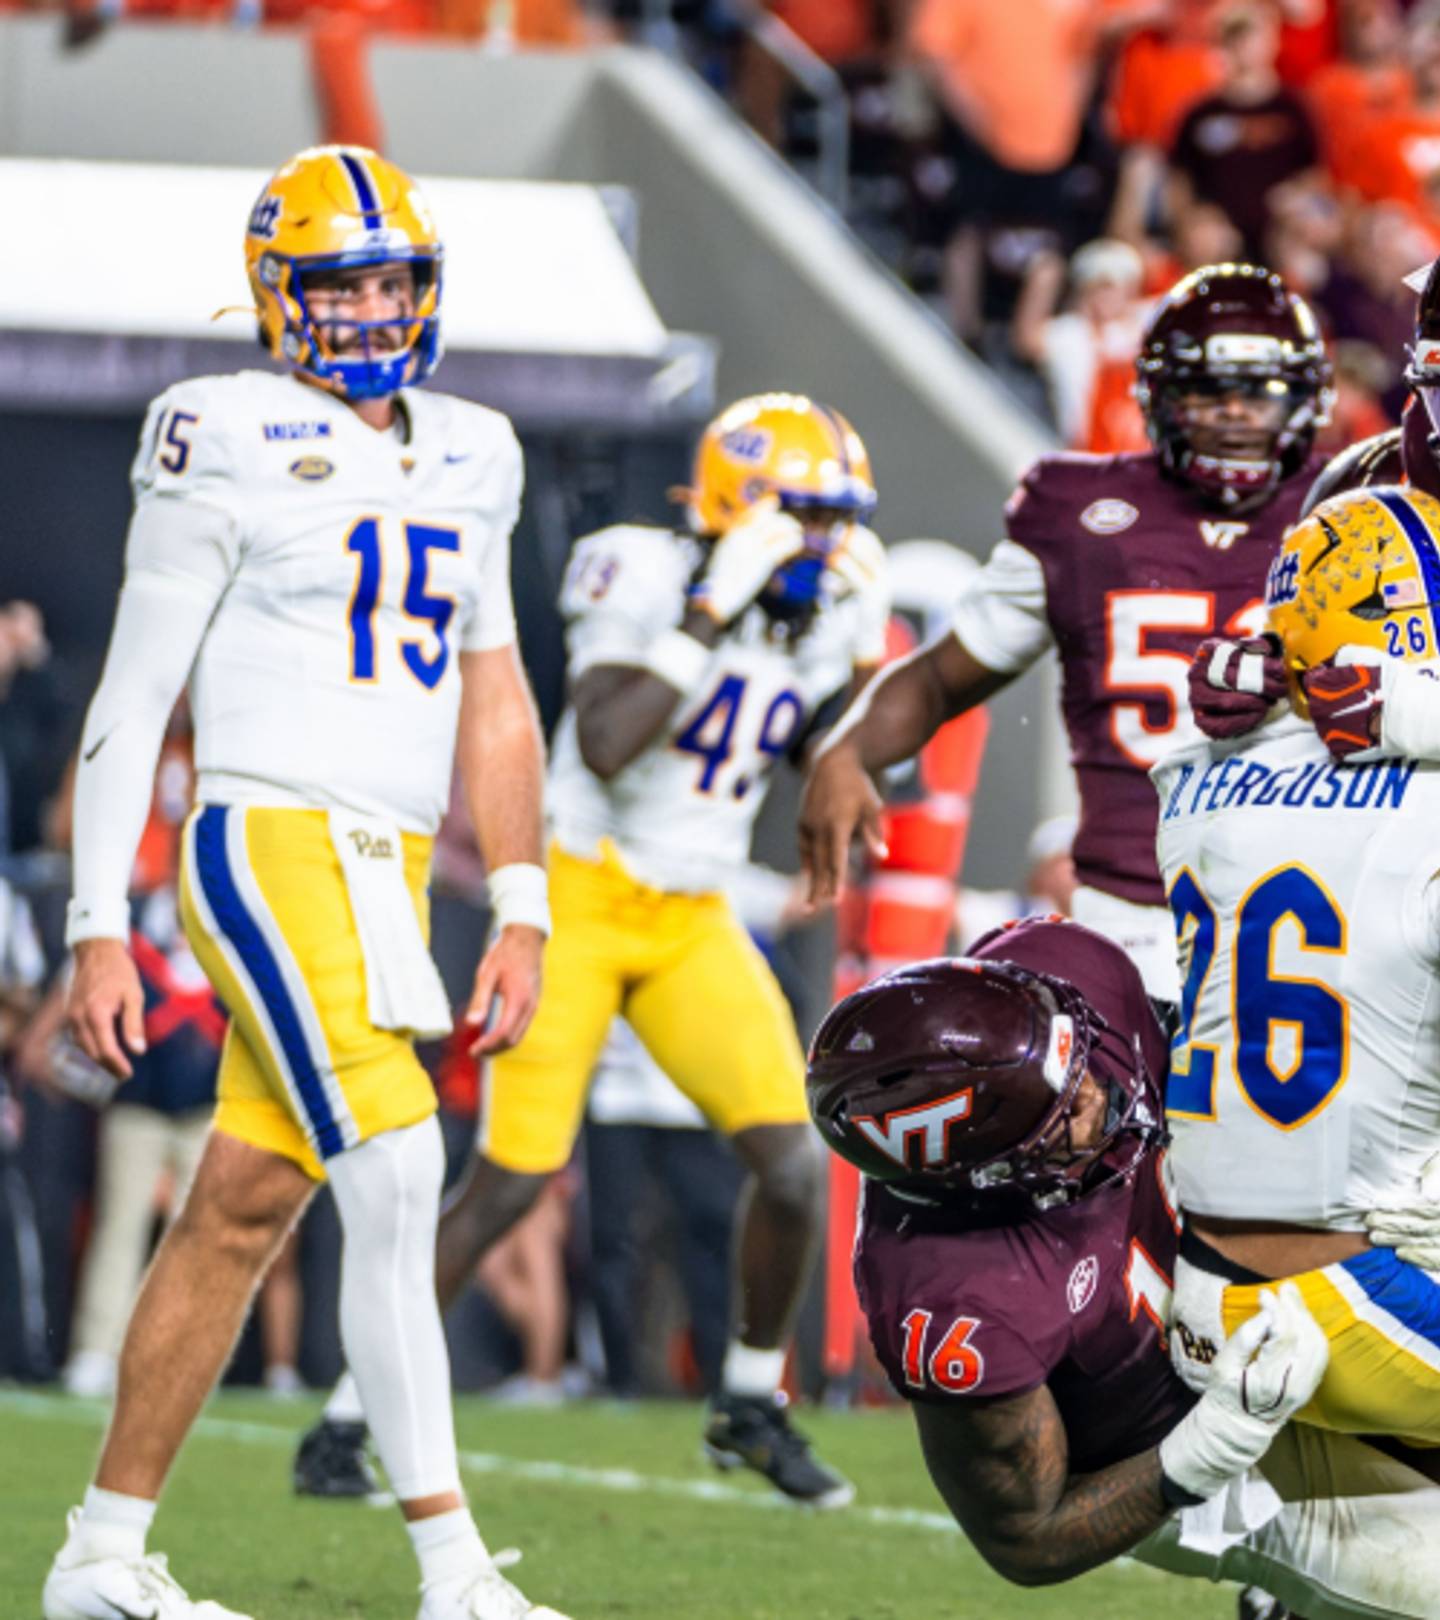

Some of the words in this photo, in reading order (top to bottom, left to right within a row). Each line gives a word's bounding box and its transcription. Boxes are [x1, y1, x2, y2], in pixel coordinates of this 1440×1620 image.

[1200, 520, 1249, 549] VT
[344, 516, 462, 691] 15
[1383, 616, 1427, 658] 26
[672, 672, 803, 796] 49
[1190, 757, 1420, 815] FERGUSON
[345, 828, 394, 859] Pitt
[1164, 860, 1351, 1132] 26
[850, 1087, 974, 1171] VT
[901, 1308, 984, 1393] 16
[1163, 1319, 1218, 1365] Pitt
